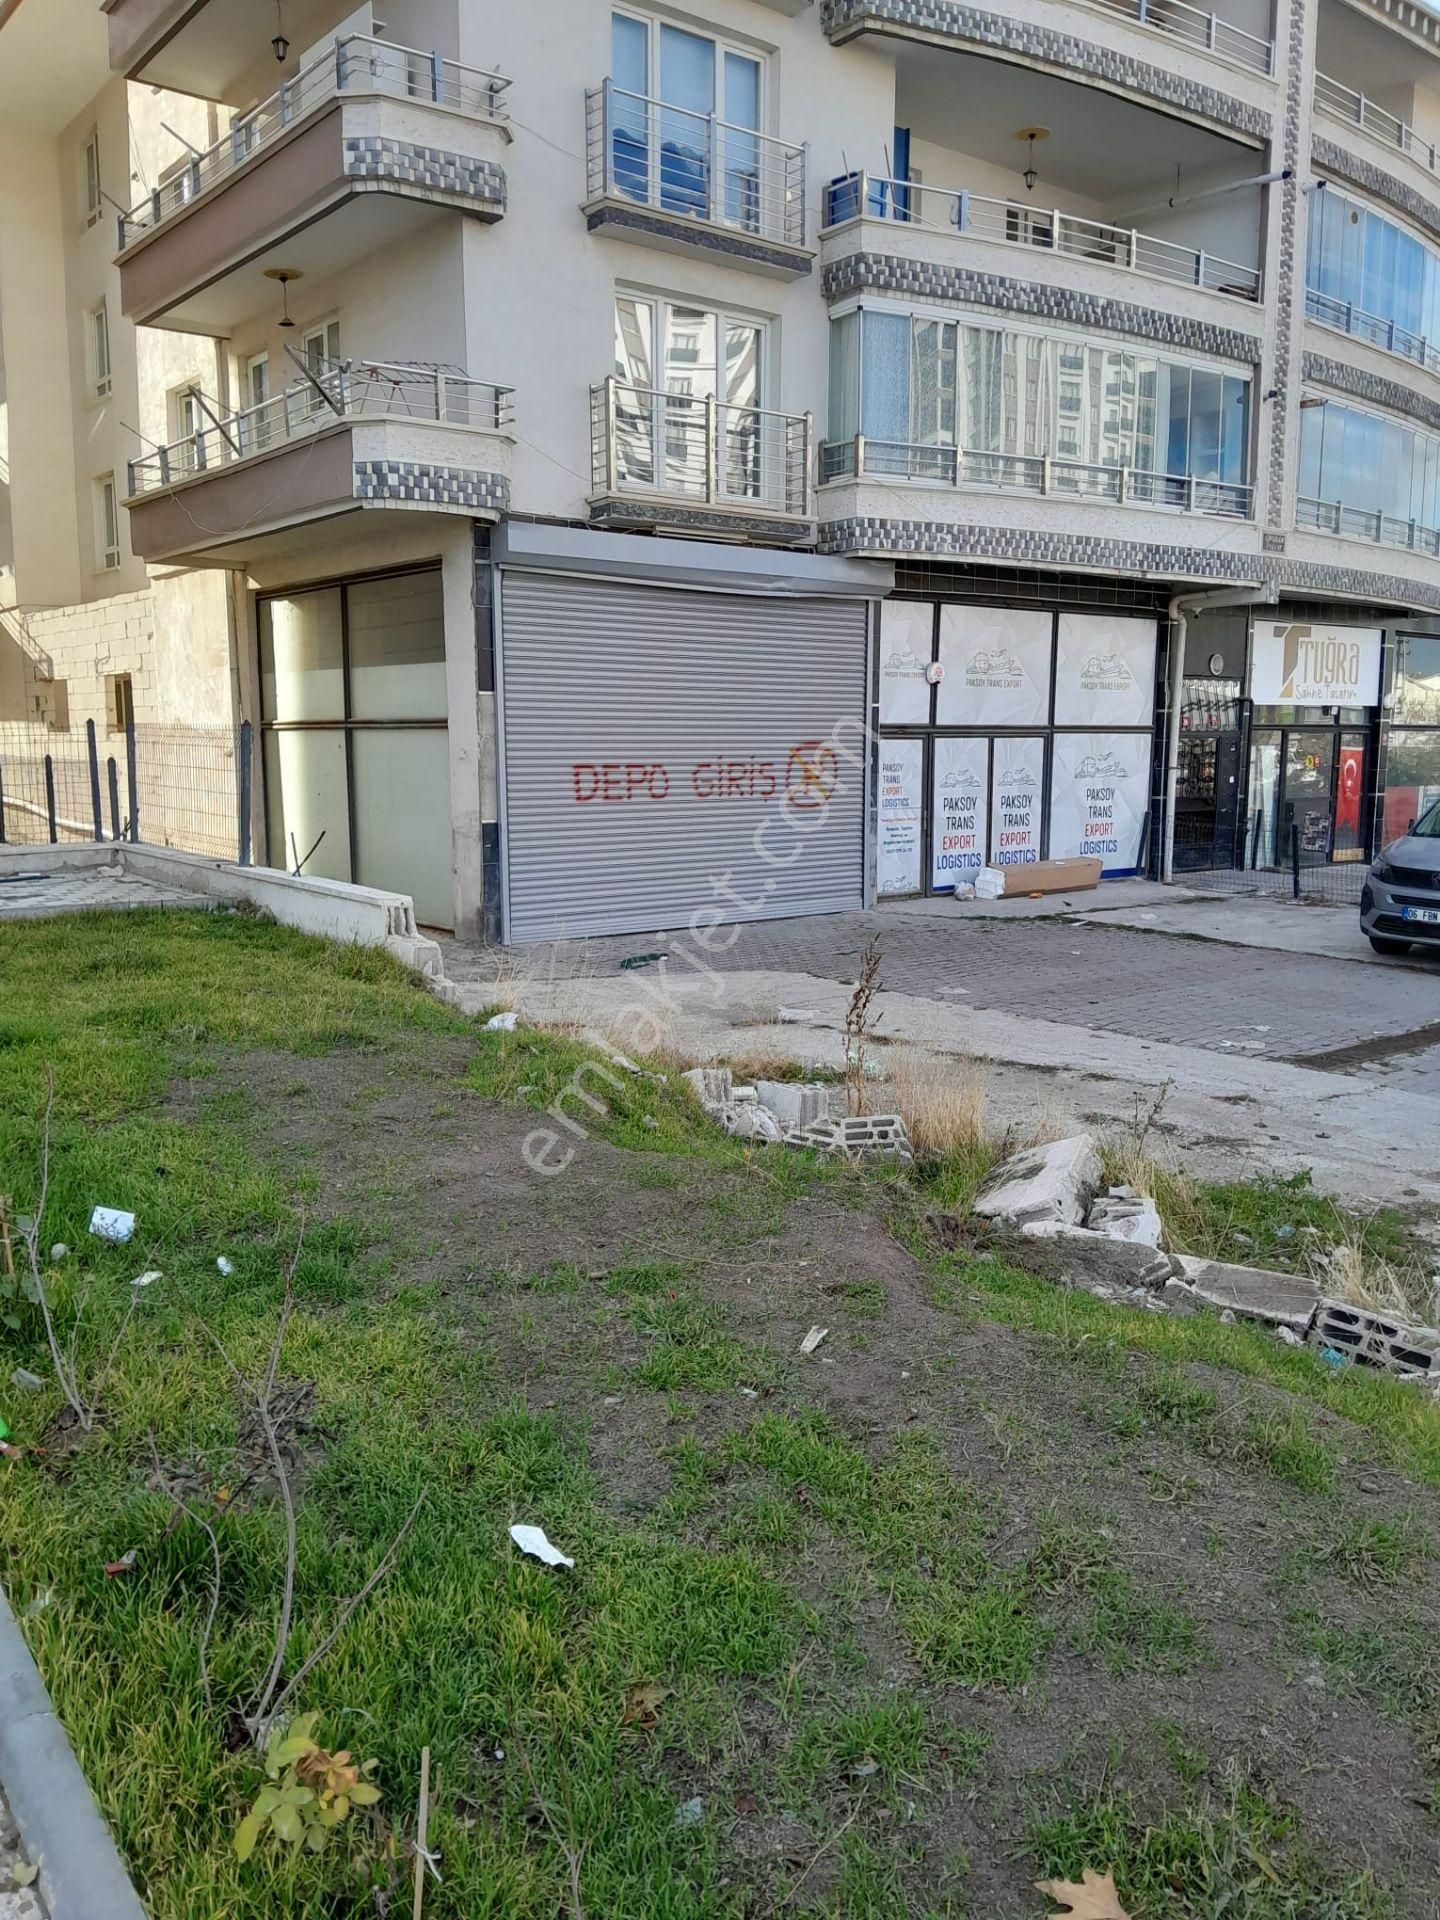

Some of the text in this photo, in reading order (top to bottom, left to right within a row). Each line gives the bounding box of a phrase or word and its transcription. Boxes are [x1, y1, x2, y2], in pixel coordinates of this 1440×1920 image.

[966, 678, 1022, 688] PAKSOY TRANS EXPORT
[1295, 684, 1322, 700] Sahne
[882, 763, 904, 773] PAKSOY
[572, 764, 670, 802] DEPO
[882, 774, 901, 784] TRANS
[882, 786, 903, 796] EXPORT
[1086, 788, 1116, 802] PAKSOY
[882, 798, 910, 808] LOGISTICS
[943, 796, 978, 812] PAKSOY
[1000, 794, 1033, 810] PAKSOY
[1088, 805, 1113, 819] TRANS
[946, 815, 975, 830] TRANS
[1003, 812, 1031, 828] TRANS
[1084, 822, 1114, 837] EXPORT
[942, 834, 977, 850] EXPORT
[1000, 831, 1032, 846] EXPORT
[1079, 839, 1118, 855] LOGISTICS
[936, 852, 982, 870] LOGISTICS
[994, 848, 1037, 865] LOGISTICS
[1408, 909, 1418, 918] 06
